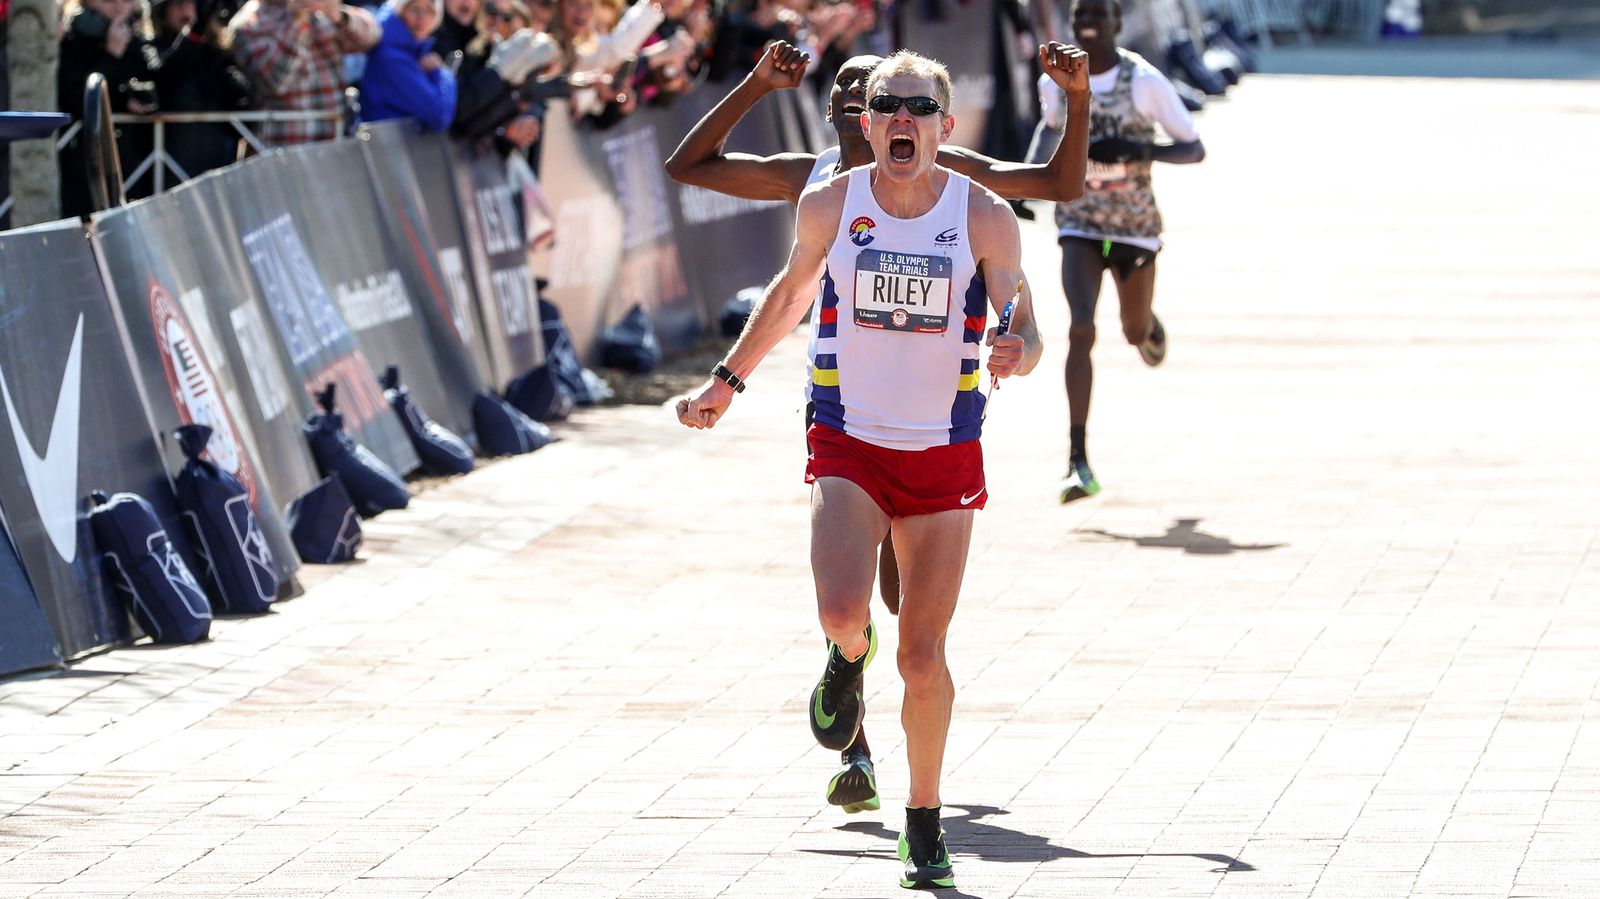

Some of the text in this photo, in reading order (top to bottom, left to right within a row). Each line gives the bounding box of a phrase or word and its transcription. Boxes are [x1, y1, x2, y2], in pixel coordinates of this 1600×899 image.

[880, 253, 929, 267] U.S. OLYMPIC
[879, 262, 929, 276] TEAM TRIALS
[873, 274, 933, 307] RILEY
